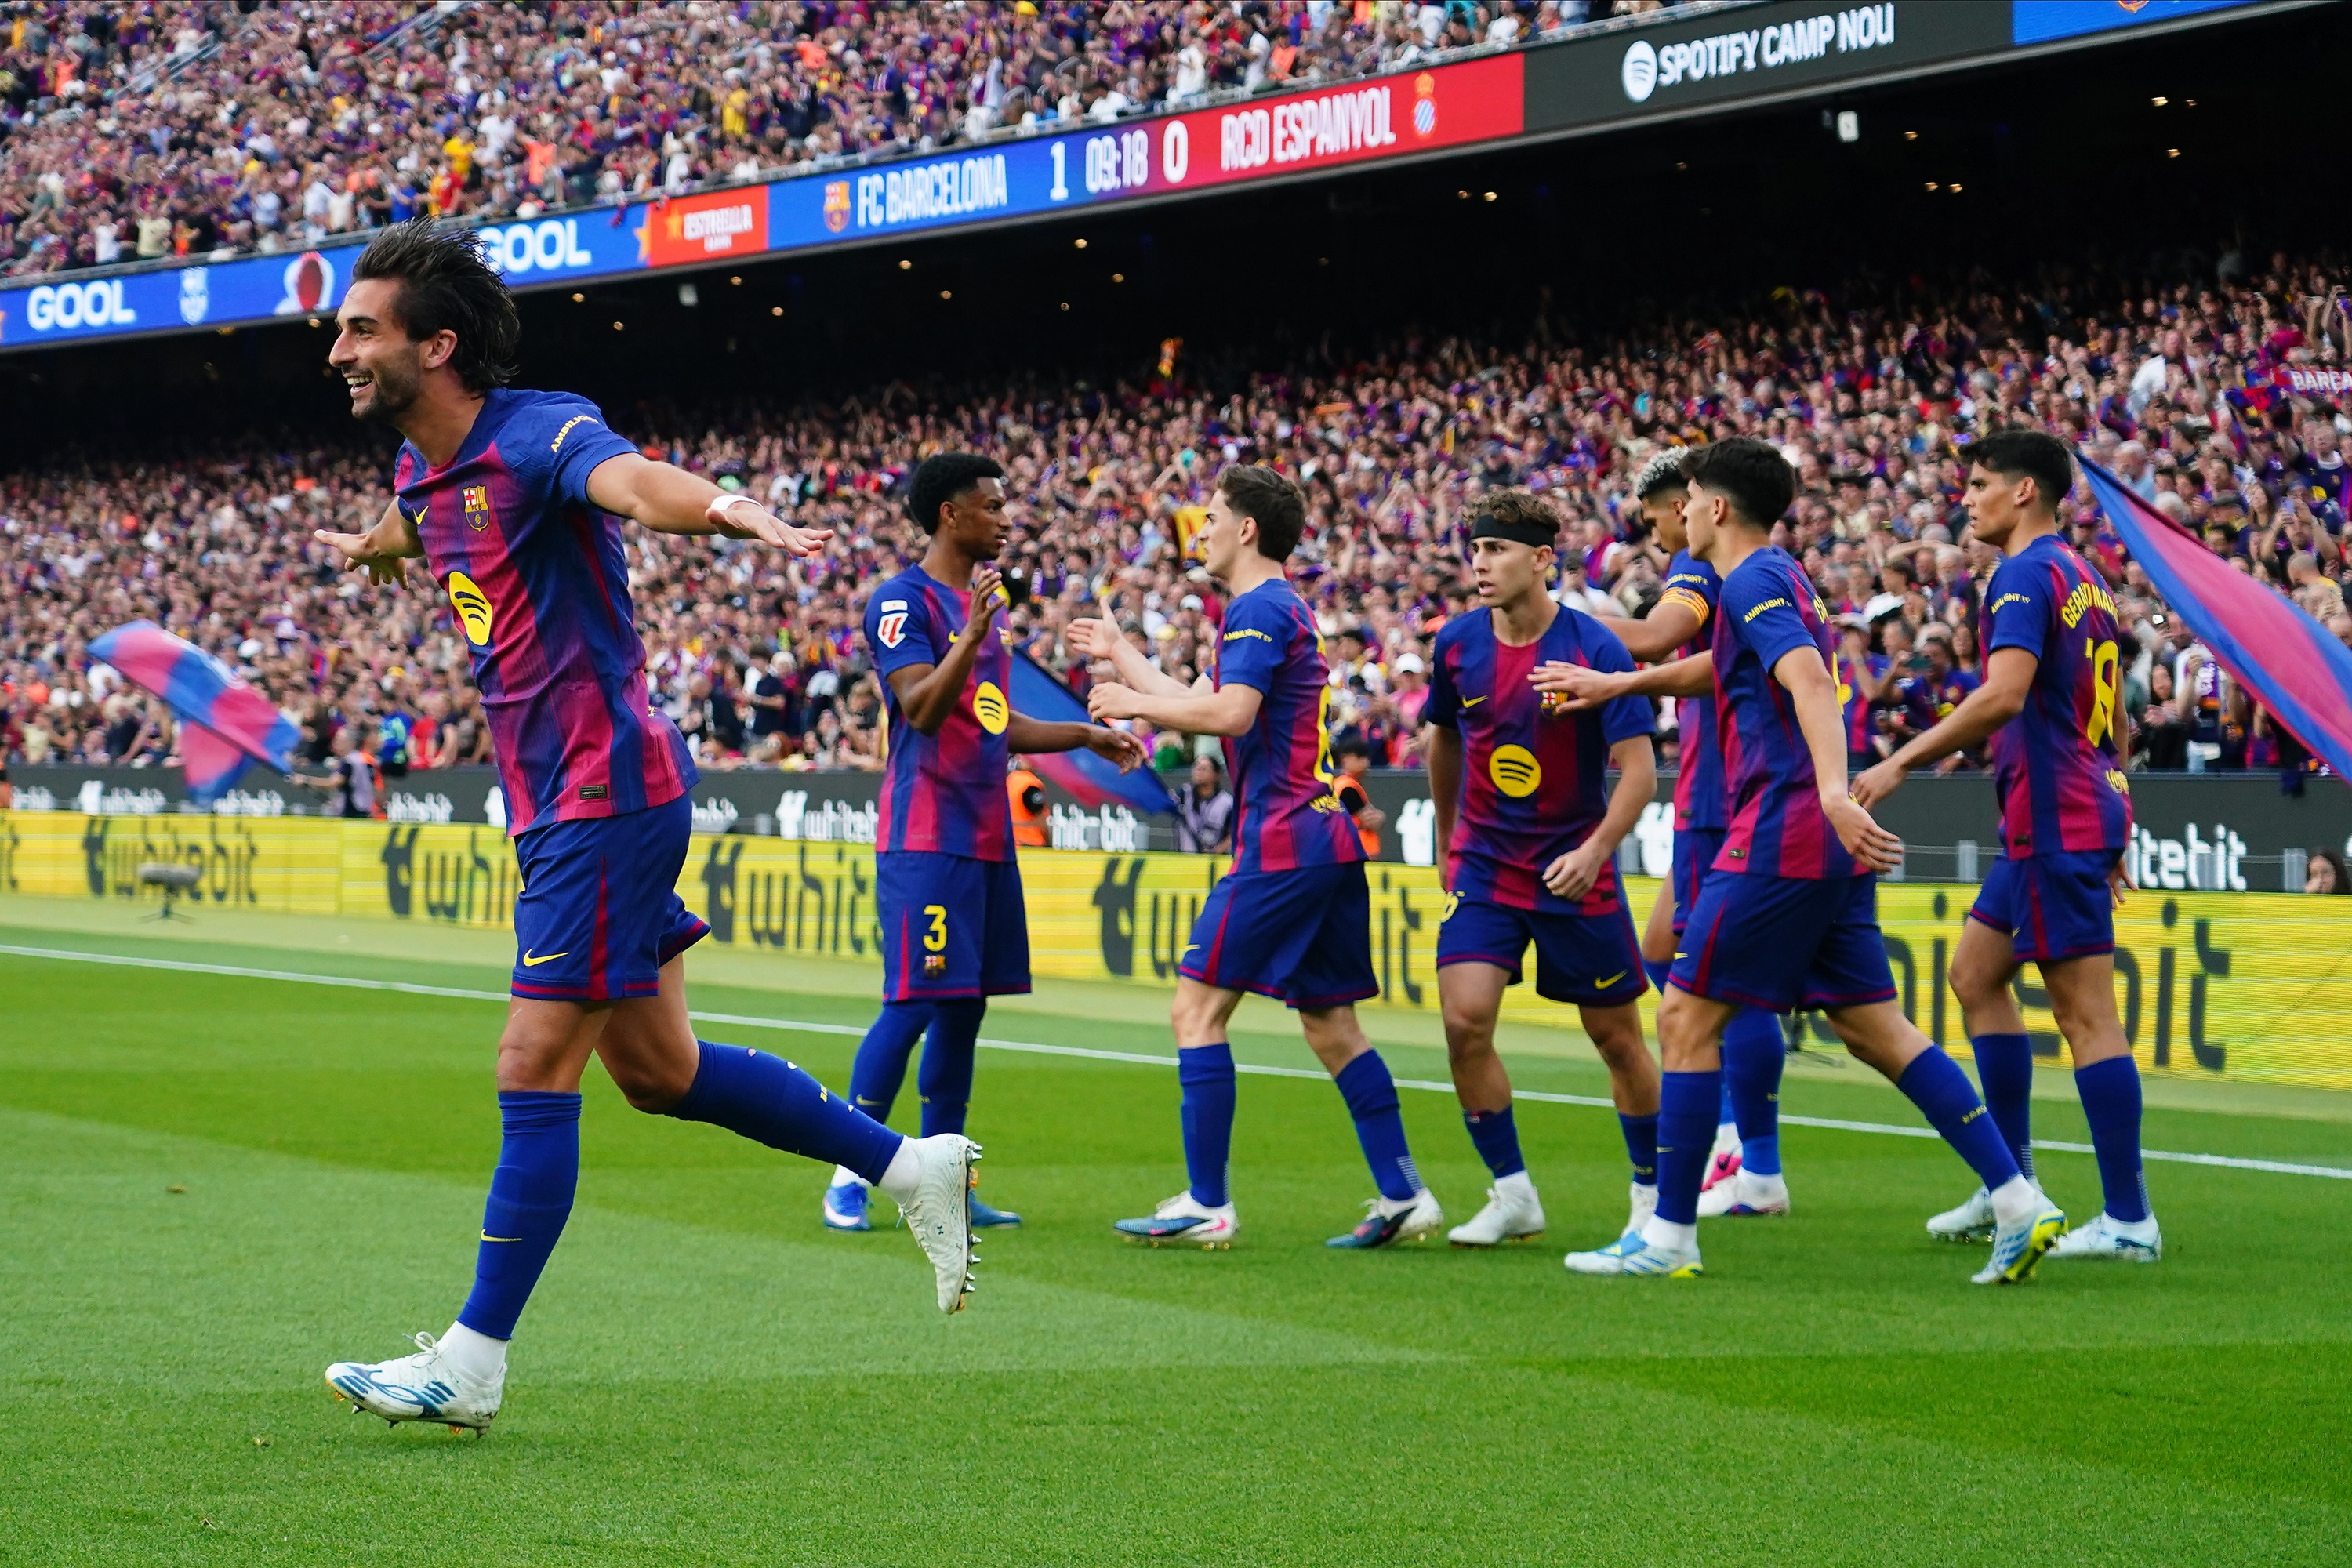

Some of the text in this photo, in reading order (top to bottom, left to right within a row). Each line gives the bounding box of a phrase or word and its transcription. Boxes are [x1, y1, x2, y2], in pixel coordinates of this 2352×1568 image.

[1657, 2, 1894, 87] SPOTIFY CAMP NOU
[857, 85, 1396, 227] FC BARCELONA 1 09:18 0 RCD ESPANYOL
[475, 219, 592, 273] GOOL
[27, 279, 136, 331] GOOL
[1743, 597, 1785, 624] AMBILIGHT
[2125, 822, 2247, 891] itebit
[923, 904, 947, 952] 3
